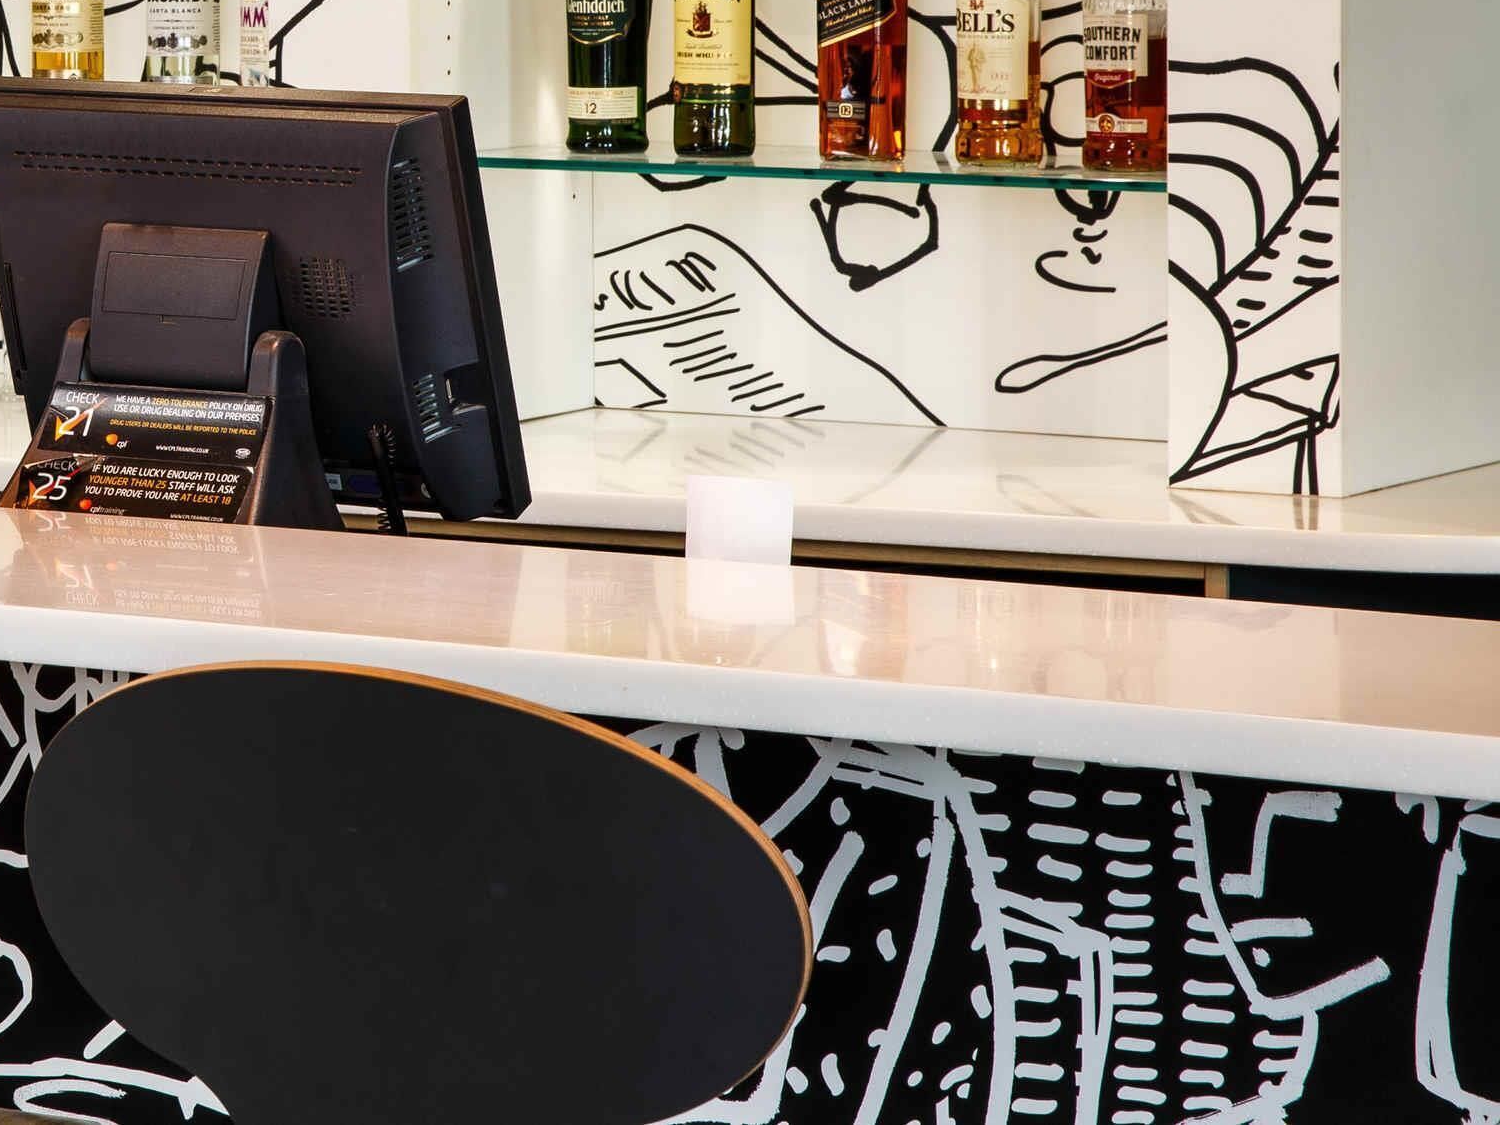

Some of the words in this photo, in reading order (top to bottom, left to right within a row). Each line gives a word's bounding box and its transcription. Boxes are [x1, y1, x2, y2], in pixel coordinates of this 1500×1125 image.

[585, 102, 598, 115] 12
[66, 391, 101, 405] CHECK
[116, 394, 127, 404] WE
[126, 395, 145, 405] HAVE
[151, 397, 170, 406] ZERO
[169, 398, 209, 408] TOLERANCE
[209, 401, 233, 411] POLICY
[233, 403, 243, 411] ON
[243, 403, 263, 413] DRUG
[59, 406, 94, 437] 21
[114, 404, 129, 413] USE
[129, 405, 140, 413] OR
[140, 406, 162, 415] DRUG
[162, 407, 195, 418] DEALING
[195, 410, 208, 418] ON
[208, 410, 224, 420] OUR
[225, 412, 261, 422] PREMISES
[92, 462, 102, 473] IF
[102, 464, 120, 475] YOU
[120, 466, 137, 476] ARE
[140, 467, 167, 479] LUCKY
[167, 469, 202, 481] ENOUGH
[204, 472, 215, 482] TO
[217, 473, 240, 484] LOOK
[33, 473, 71, 501] 25
[90, 475, 128, 486] YOUNGER
[131, 478, 155, 488] THAN
[155, 480, 167, 489] 25
[168, 481, 196, 492] STAFF
[196, 483, 217, 493] WILL
[217, 484, 237, 495] ASK
[85, 485, 102, 495] YOU
[103, 486, 115, 495] TO
[115, 487, 143, 498] PROVE
[143, 490, 162, 500] YOU
[162, 491, 180, 501] ARE
[180, 493, 191, 503] AT
[192, 494, 220, 504] LEAST
[221, 496, 233, 506] 18
